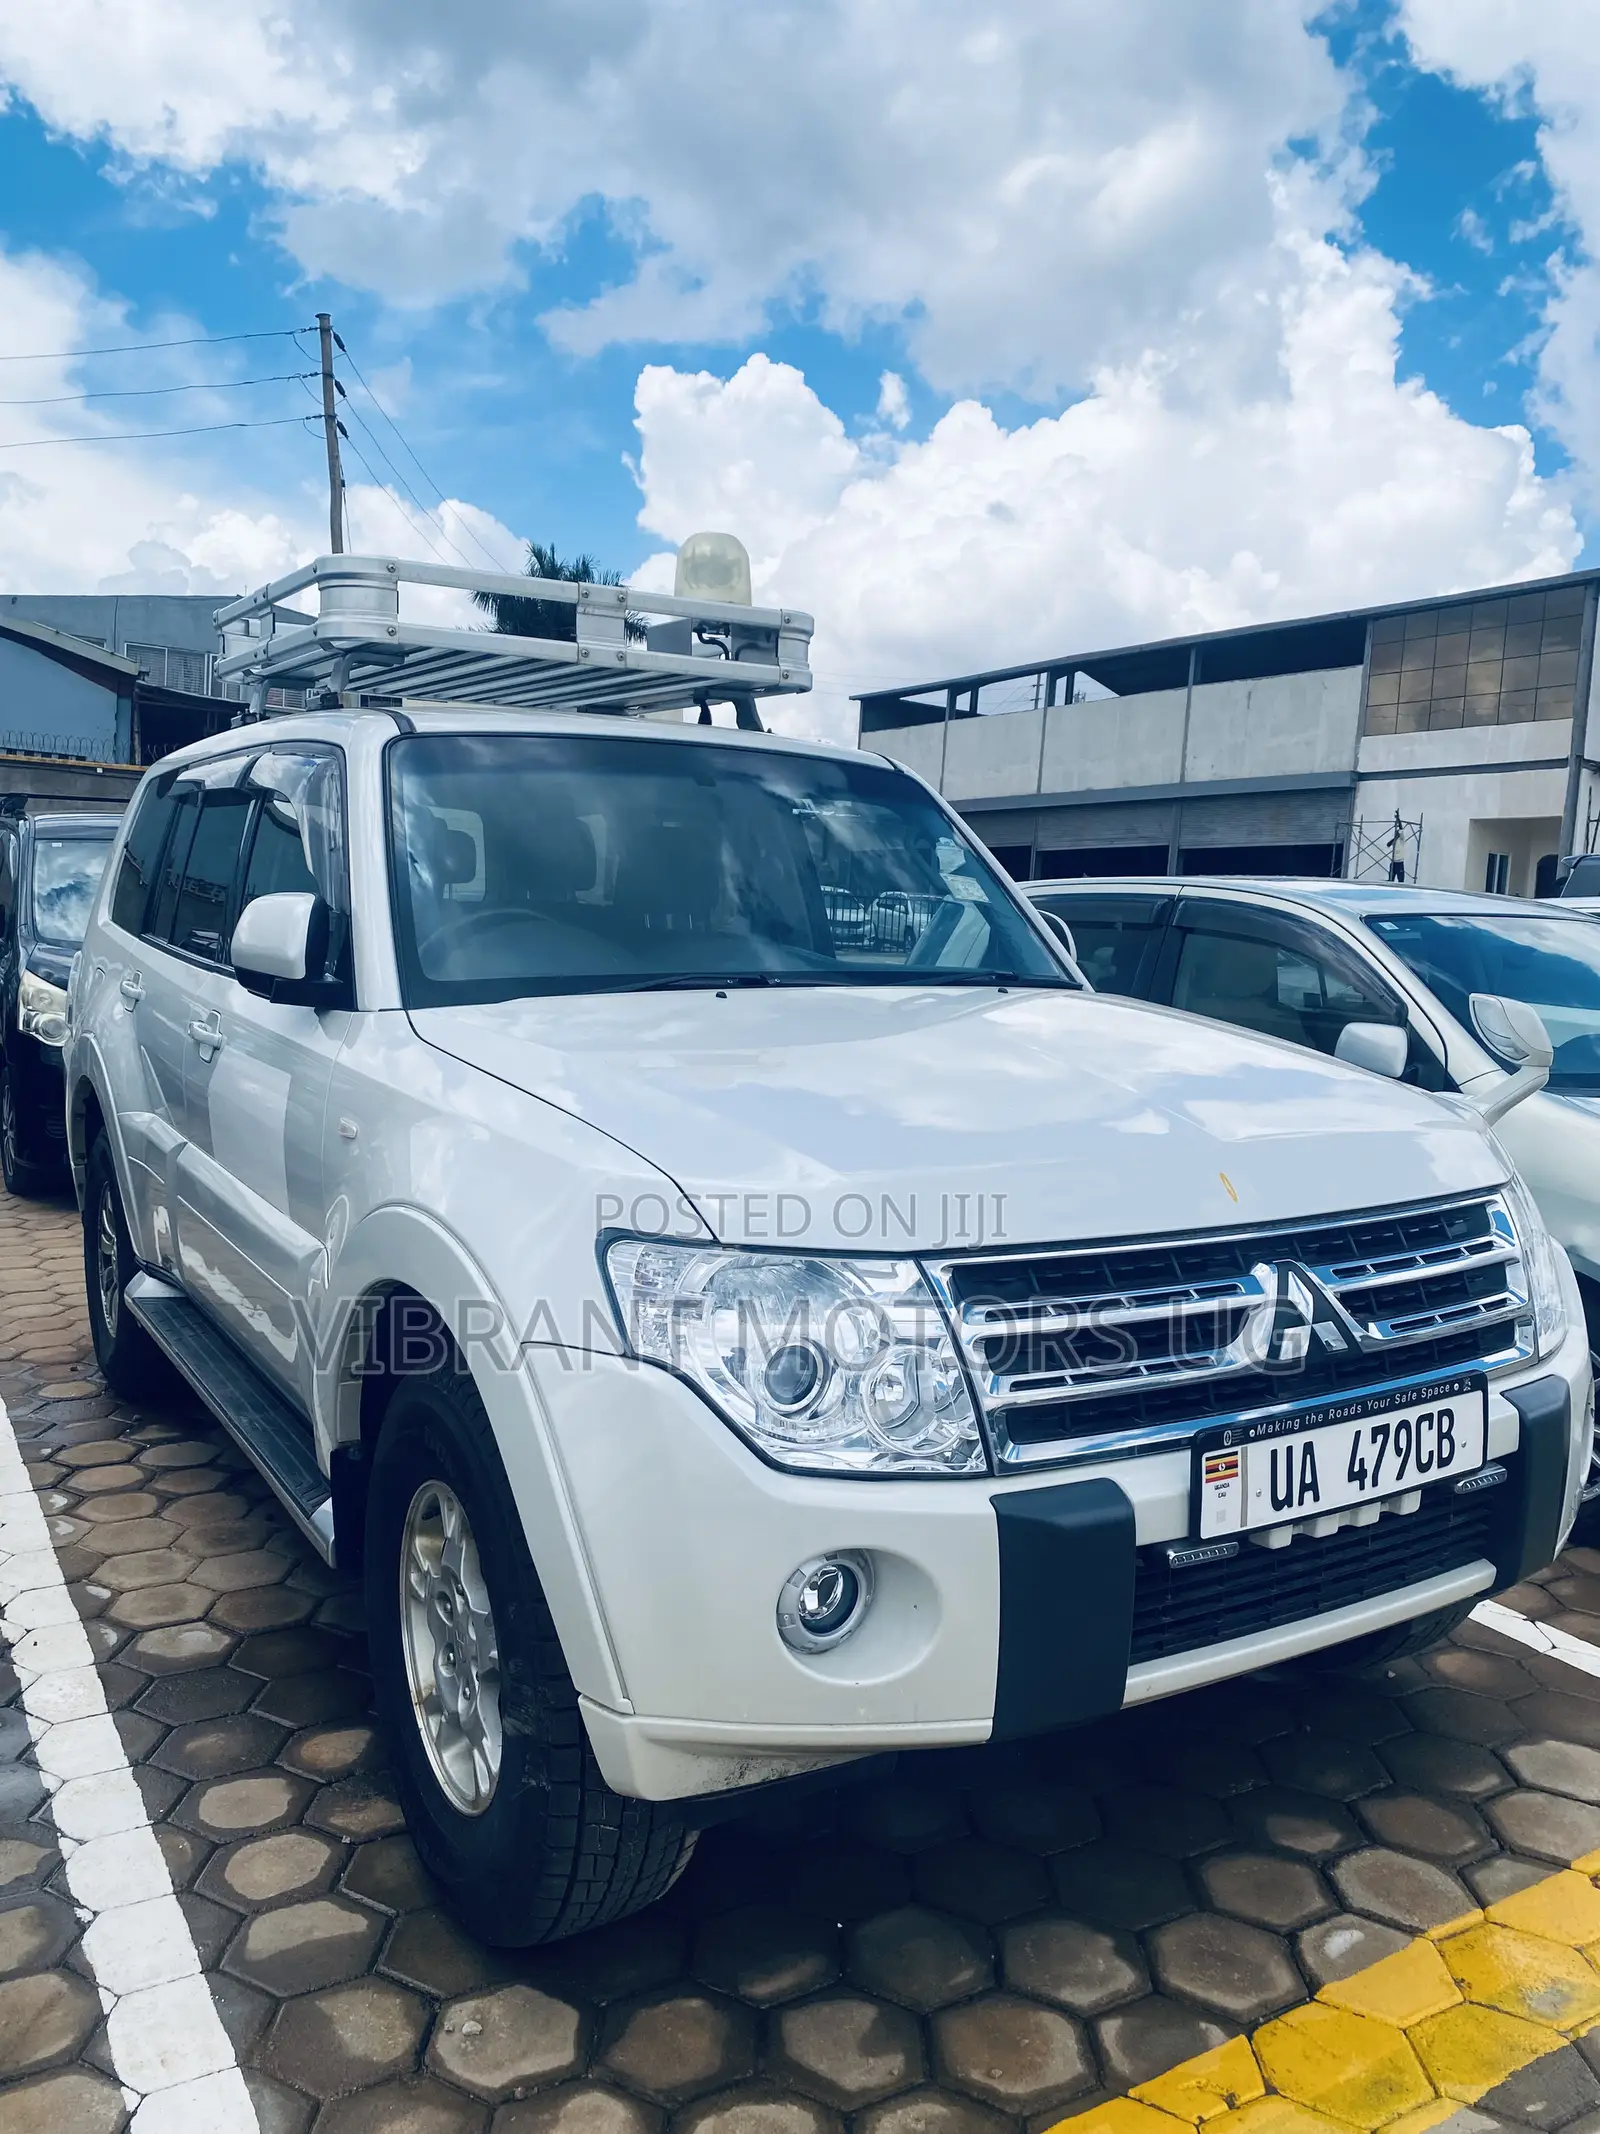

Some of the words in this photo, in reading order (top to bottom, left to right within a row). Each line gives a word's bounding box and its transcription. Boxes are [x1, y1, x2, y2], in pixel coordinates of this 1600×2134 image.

[1257, 1419, 1300, 1436] Making
[1305, 1413, 1323, 1425] the
[1329, 1403, 1362, 1420] Roads
[1367, 1399, 1390, 1411] Your
[1394, 1391, 1417, 1404] Safe
[1421, 1384, 1450, 1399] Space
[1270, 1440, 1320, 1511] UA
[1347, 1408, 1455, 1491] 479CB
